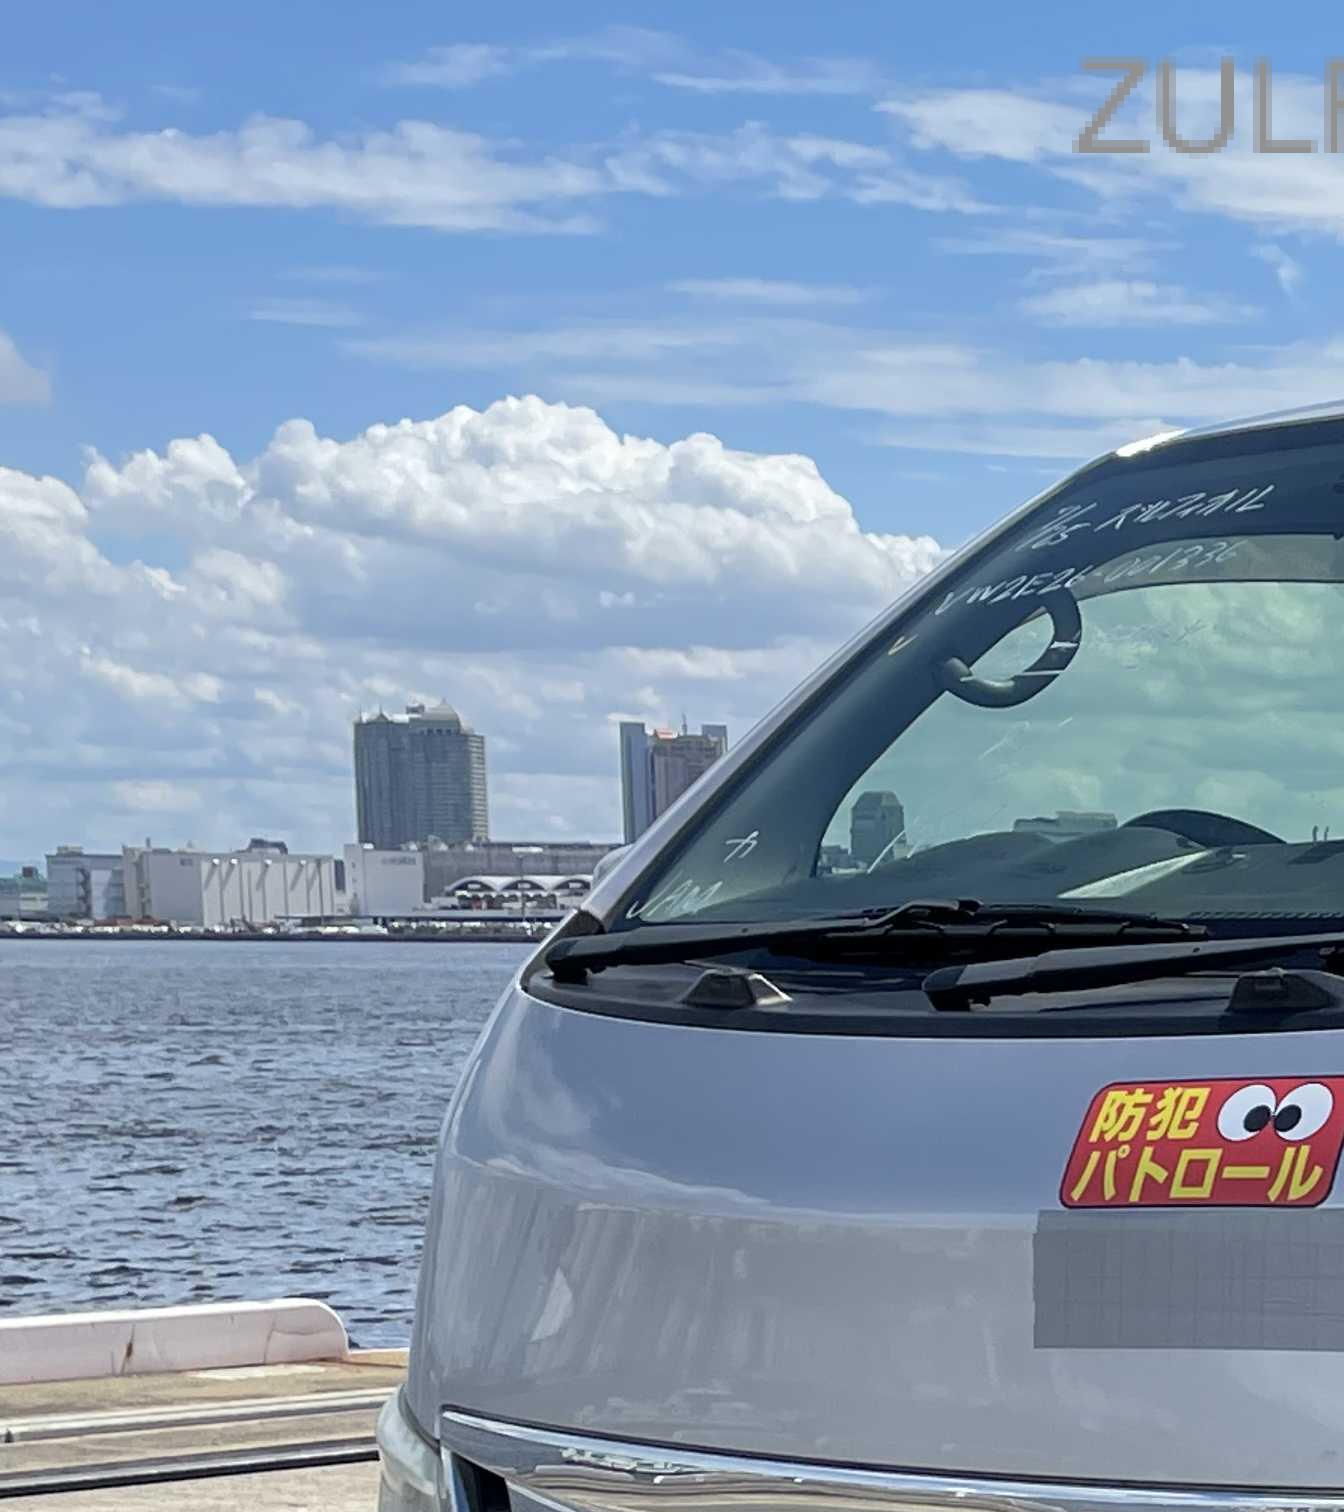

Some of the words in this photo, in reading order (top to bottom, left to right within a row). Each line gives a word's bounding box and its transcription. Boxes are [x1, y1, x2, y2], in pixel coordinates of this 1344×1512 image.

[1088, 1086, 1212, 1144] 防犯
[1070, 1145, 1325, 1203] パトロール
